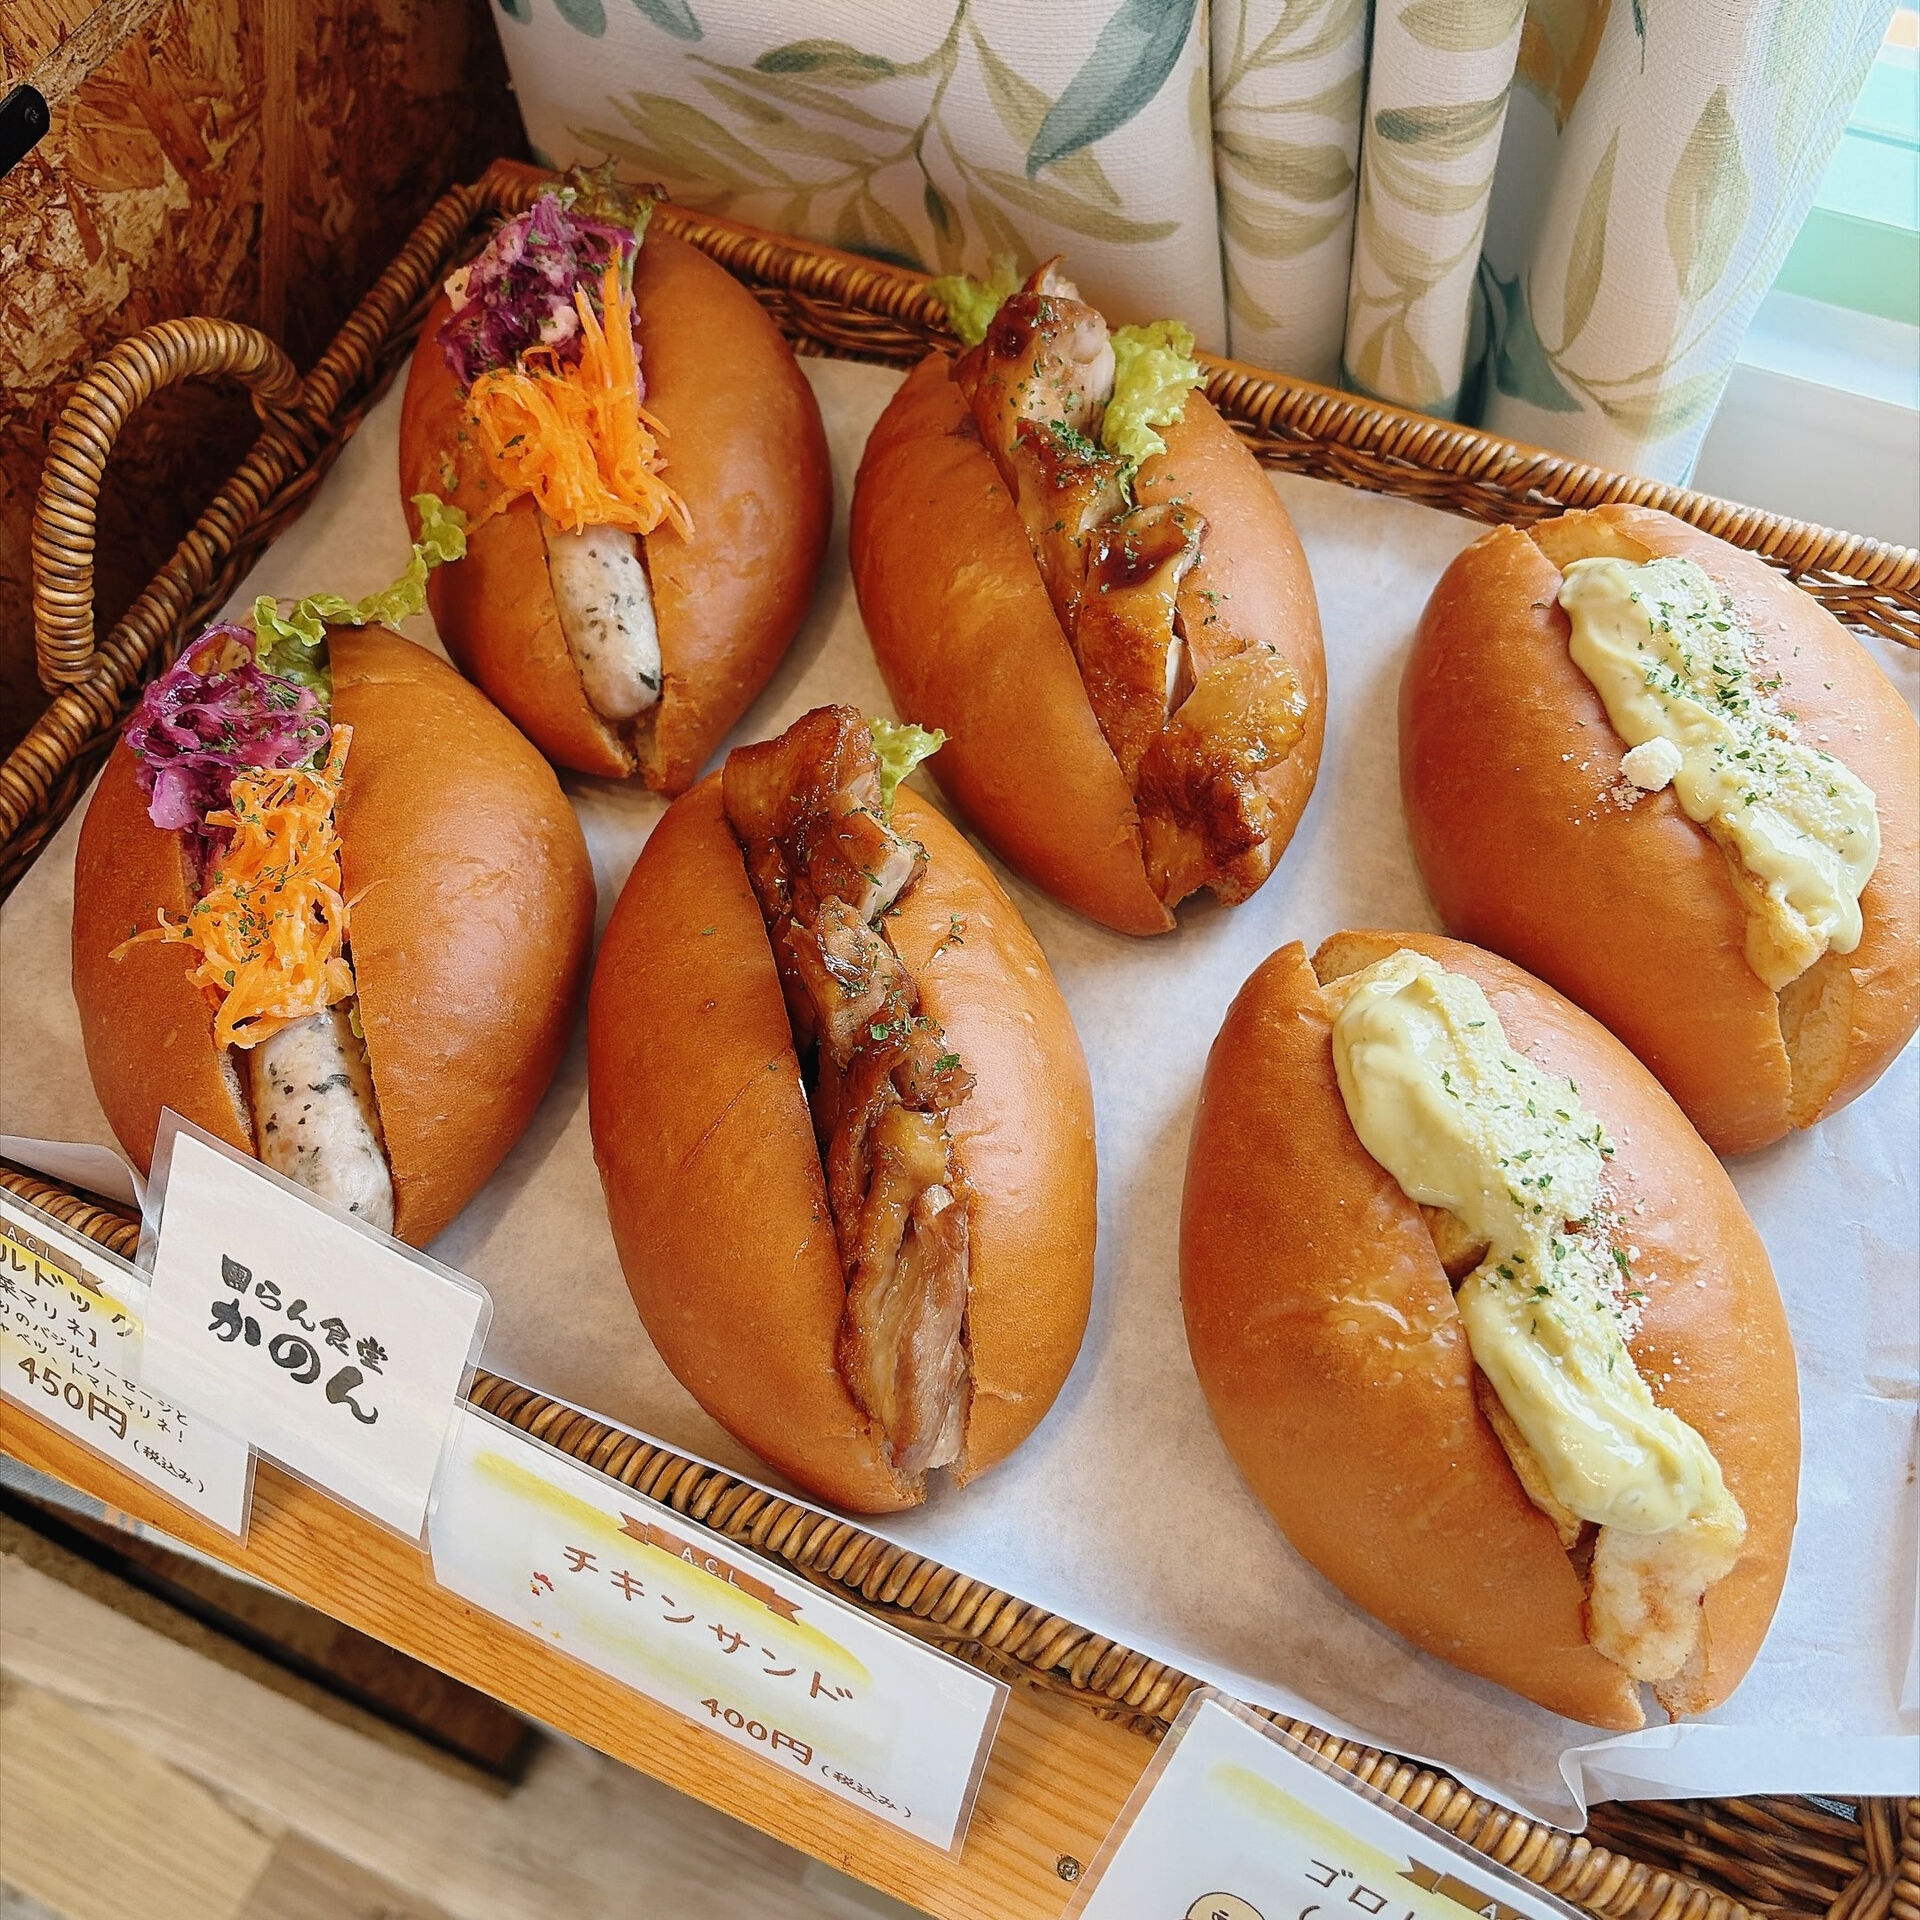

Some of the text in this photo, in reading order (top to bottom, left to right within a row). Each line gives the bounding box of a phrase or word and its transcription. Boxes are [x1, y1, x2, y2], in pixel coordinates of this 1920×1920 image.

[18, 1357, 128, 1440] 450円
[207, 1298, 379, 1425] かのん
[562, 1545, 854, 1703] チキンサンド
[699, 1697, 813, 1766] 400円
